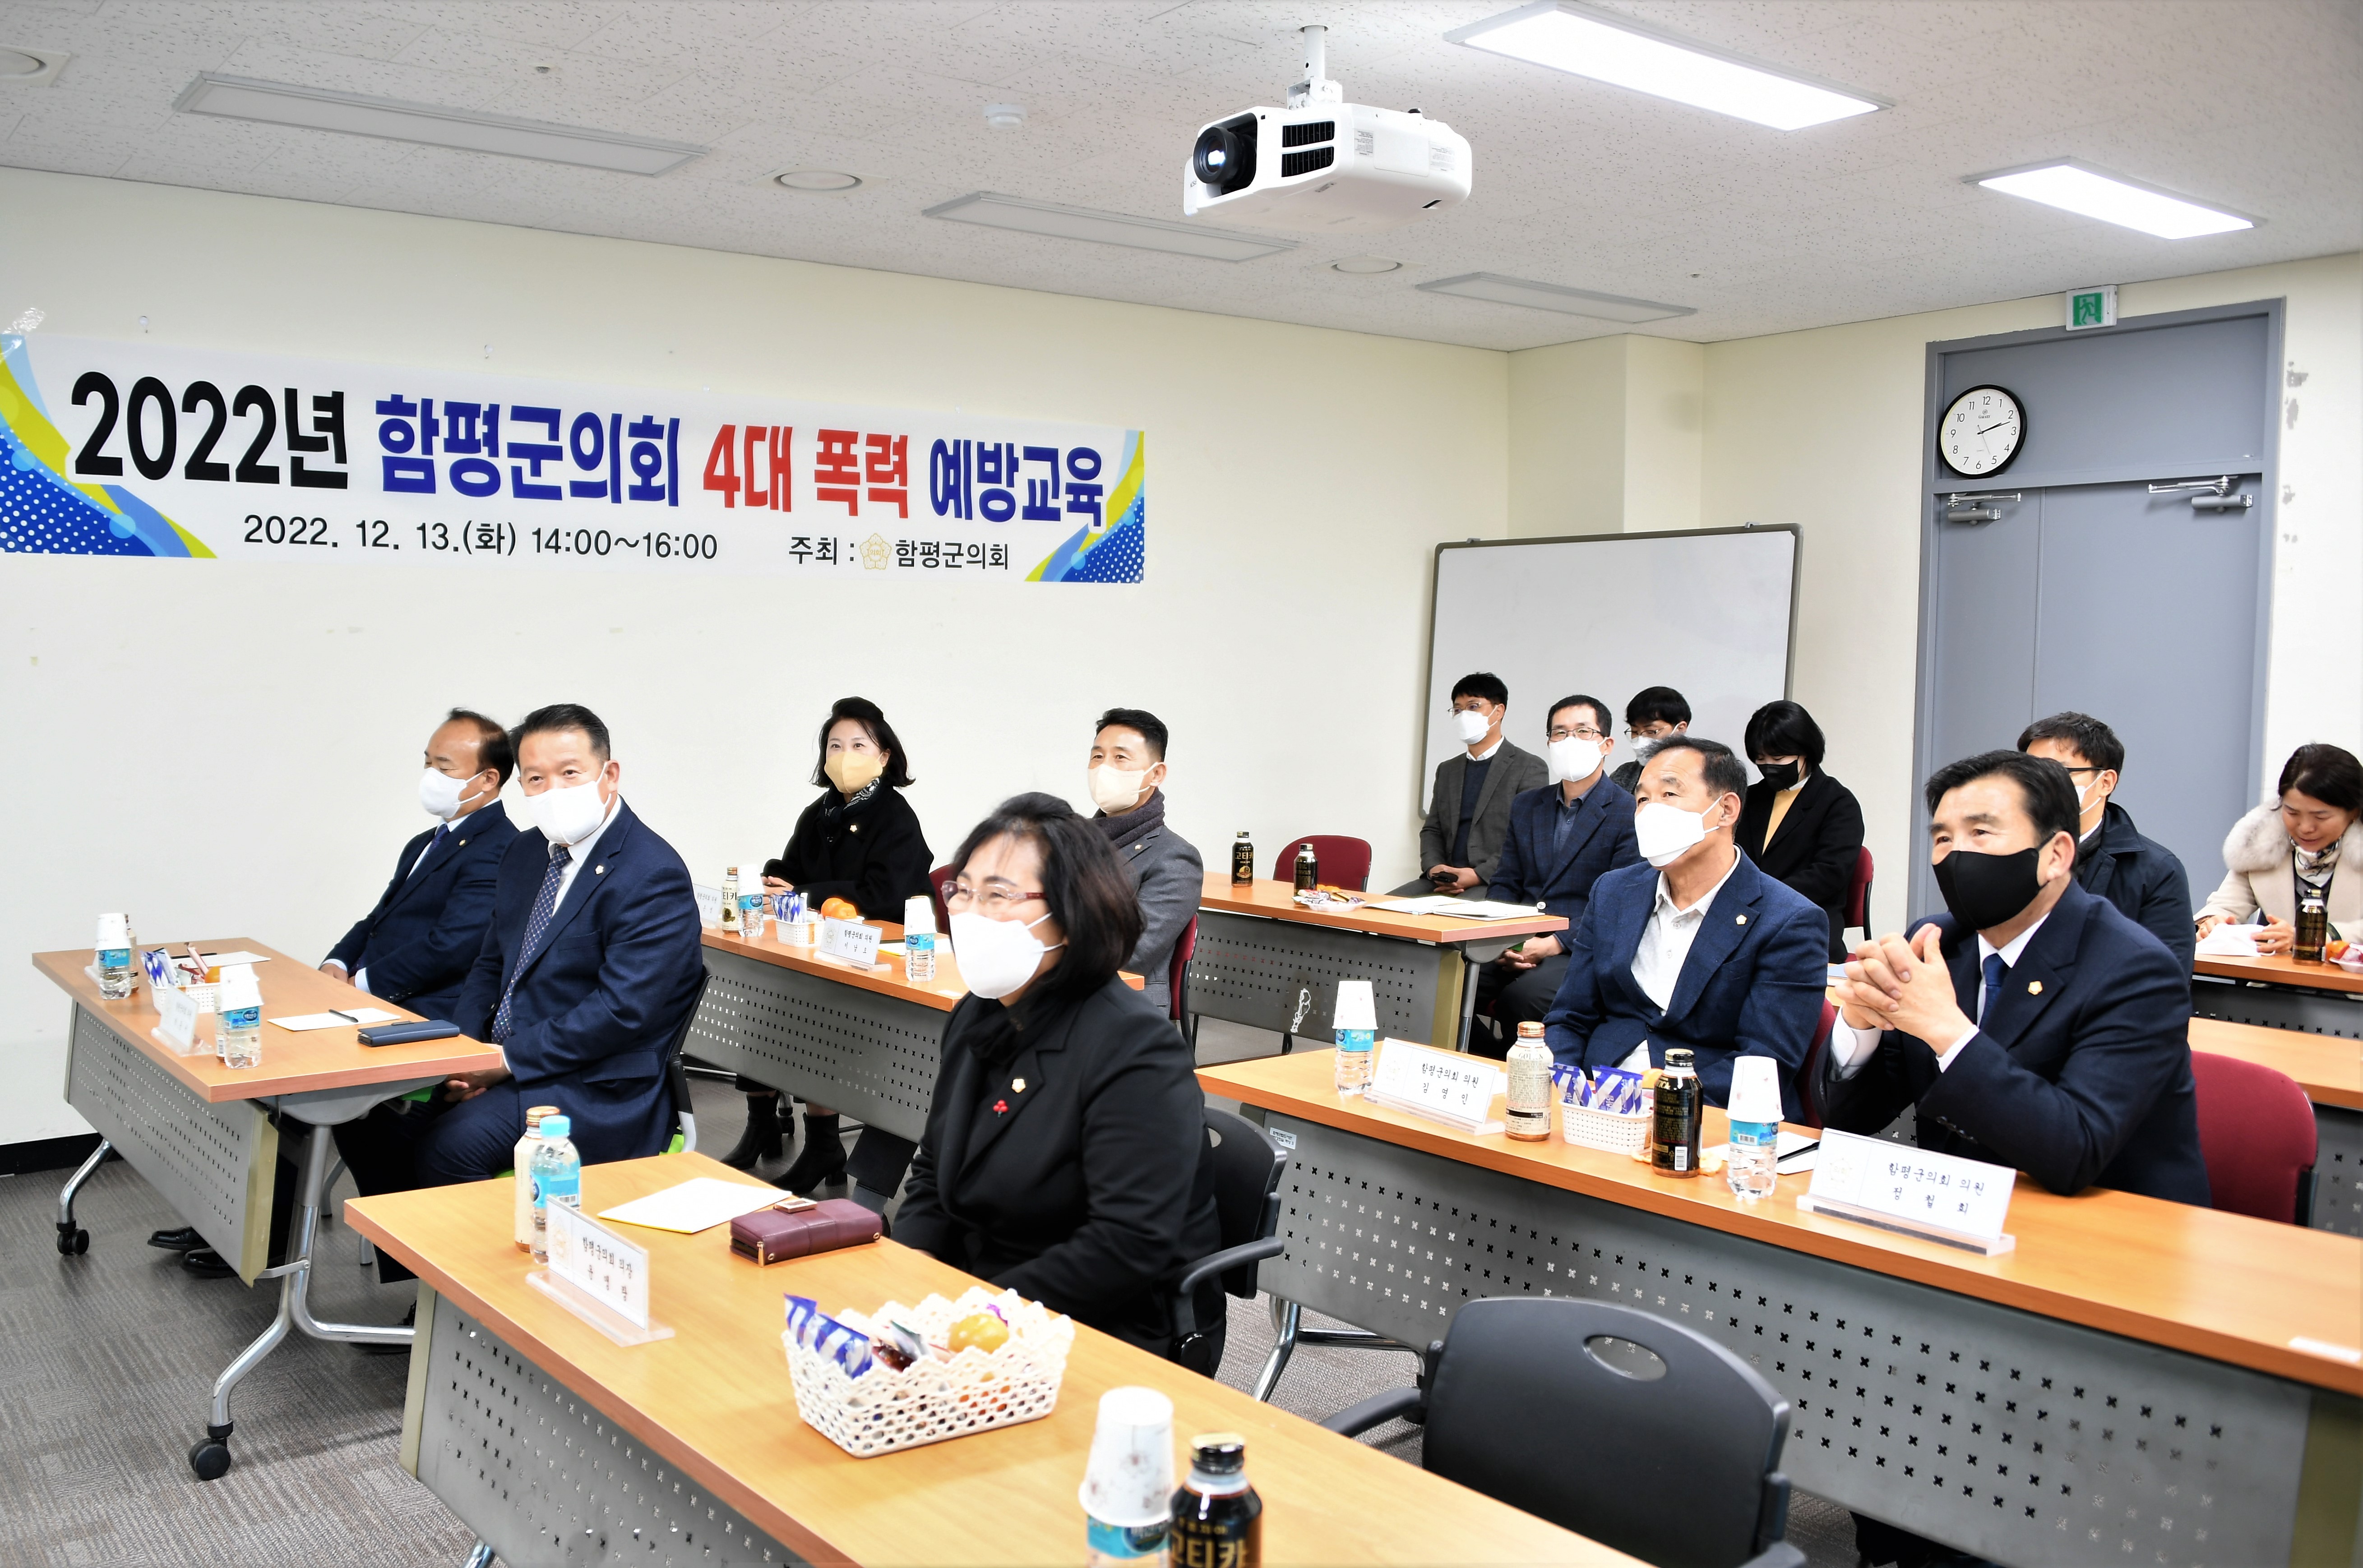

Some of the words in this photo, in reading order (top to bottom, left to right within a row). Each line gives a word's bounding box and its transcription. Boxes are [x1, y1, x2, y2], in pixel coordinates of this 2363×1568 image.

[1969, 401, 1975, 410] 11
[1983, 396, 1991, 405] 12
[1999, 399, 2002, 408] 1
[1956, 413, 1965, 422] 10
[2007, 410, 2014, 419] 2
[1950, 429, 1956, 438] 9
[2011, 426, 2016, 436] 3
[71, 372, 348, 489] 2022년
[376, 394, 680, 507] 함평군의회
[703, 424, 793, 512] 4대
[814, 429, 908, 518] 폭력
[929, 438, 1103, 527] 예방교육
[1952, 445, 1958, 454] 8
[2004, 443, 2010, 452] 4
[1963, 457, 1969, 466] 7
[1975, 460, 1981, 470] 6
[1991, 455, 1998, 465] 5
[244, 514, 338, 548] 2022.
[356, 520, 399, 550] 12.
[416, 521, 516, 556] 13.(화)
[789, 536, 837, 565] 주최
[895, 540, 1008, 570] 함평군의회
[844, 929, 863, 939] 함평군의회
[1422, 1063, 1459, 1082] 함평군의회
[1463, 1074, 1479, 1088] 의원
[1889, 1163, 1950, 1187] 함평군의회
[1959, 1180, 1984, 1196] 의원
[583, 1237, 614, 1268] 함평군의회
